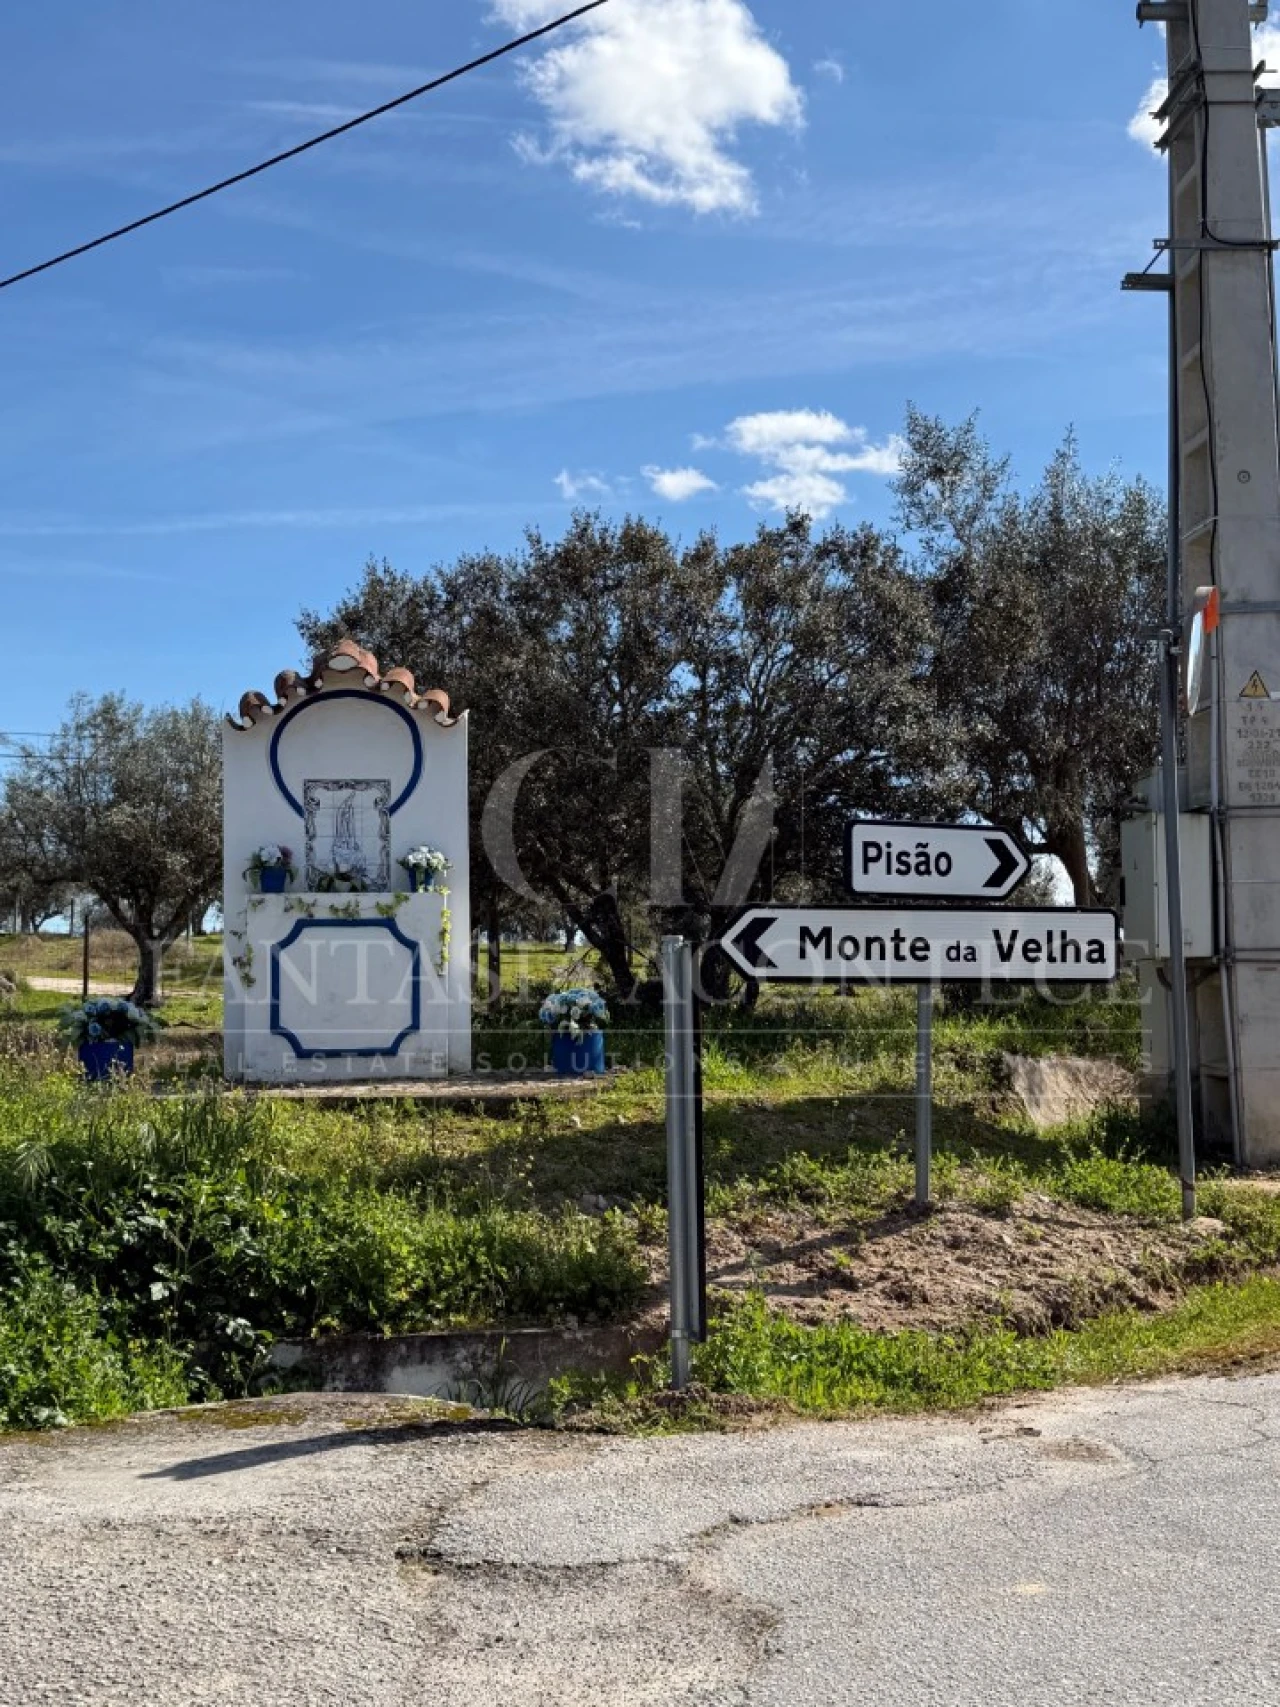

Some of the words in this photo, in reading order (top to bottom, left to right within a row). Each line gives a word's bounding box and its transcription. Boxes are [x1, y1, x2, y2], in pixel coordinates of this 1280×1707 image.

[861, 840, 953, 877] Pisão
[798, 925, 931, 962] Monte
[945, 939, 977, 963] da
[992, 929, 1107, 964] Velha
